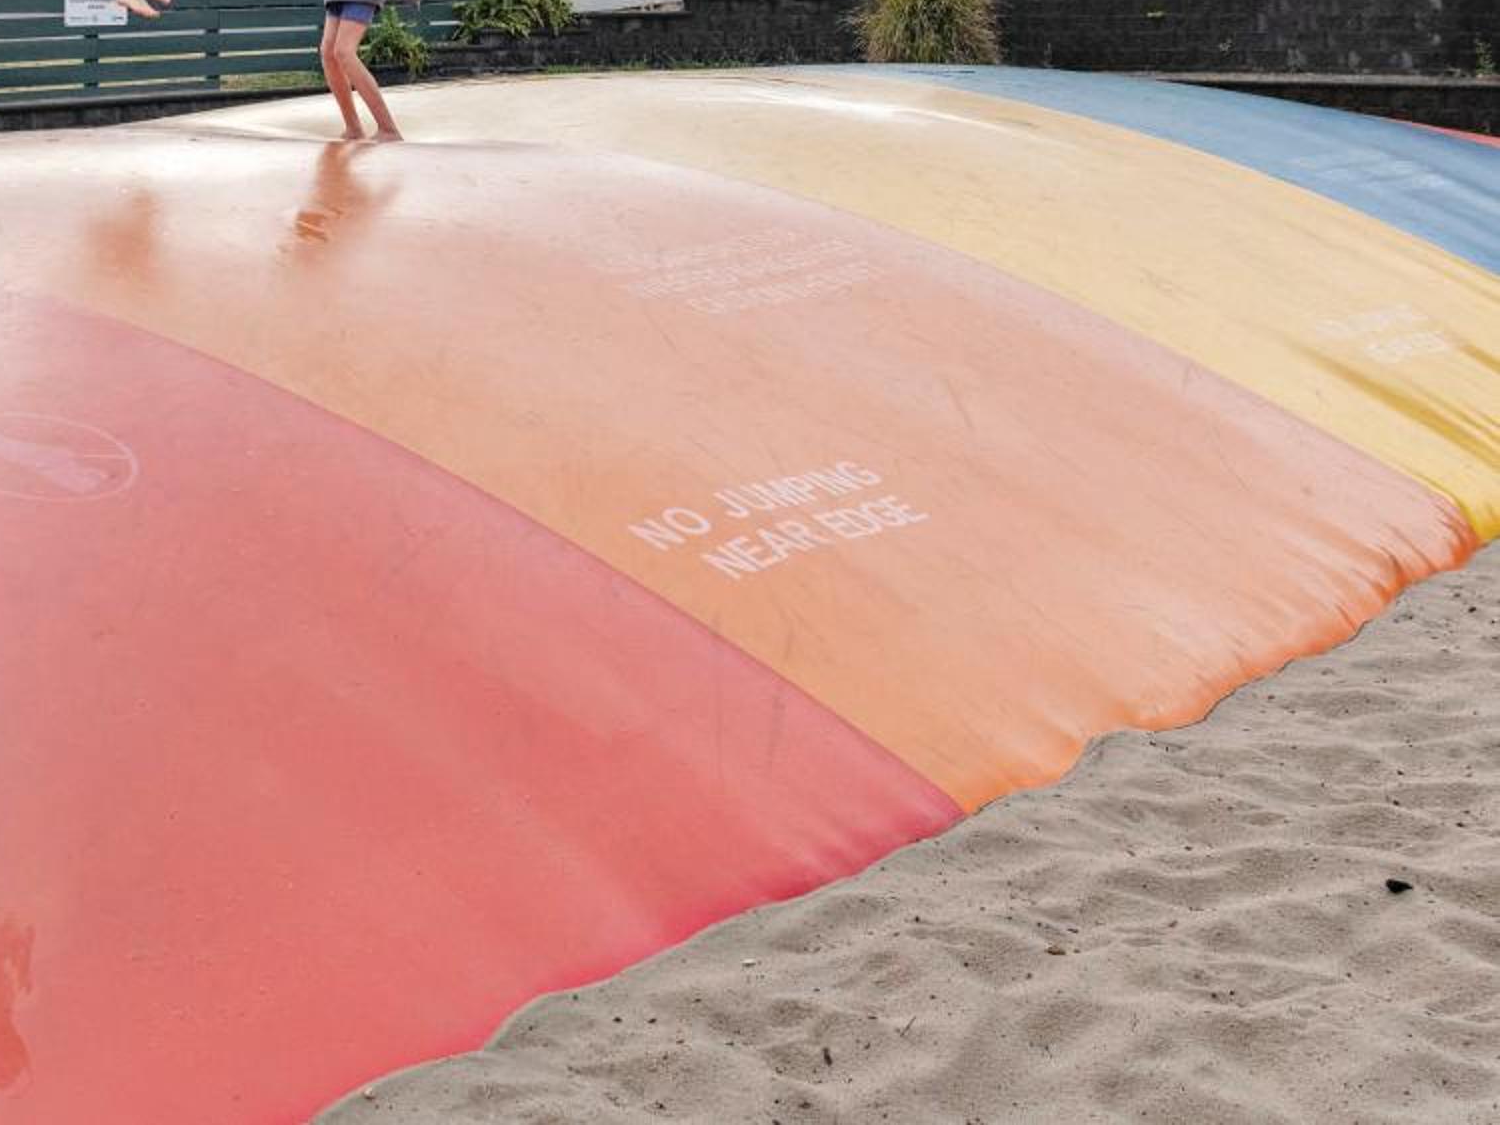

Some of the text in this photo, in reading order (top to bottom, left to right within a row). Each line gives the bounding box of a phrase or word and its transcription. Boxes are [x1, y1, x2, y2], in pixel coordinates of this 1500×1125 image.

[628, 460, 882, 551] NO JUMPING
[700, 495, 930, 579] NEAR EDGE
